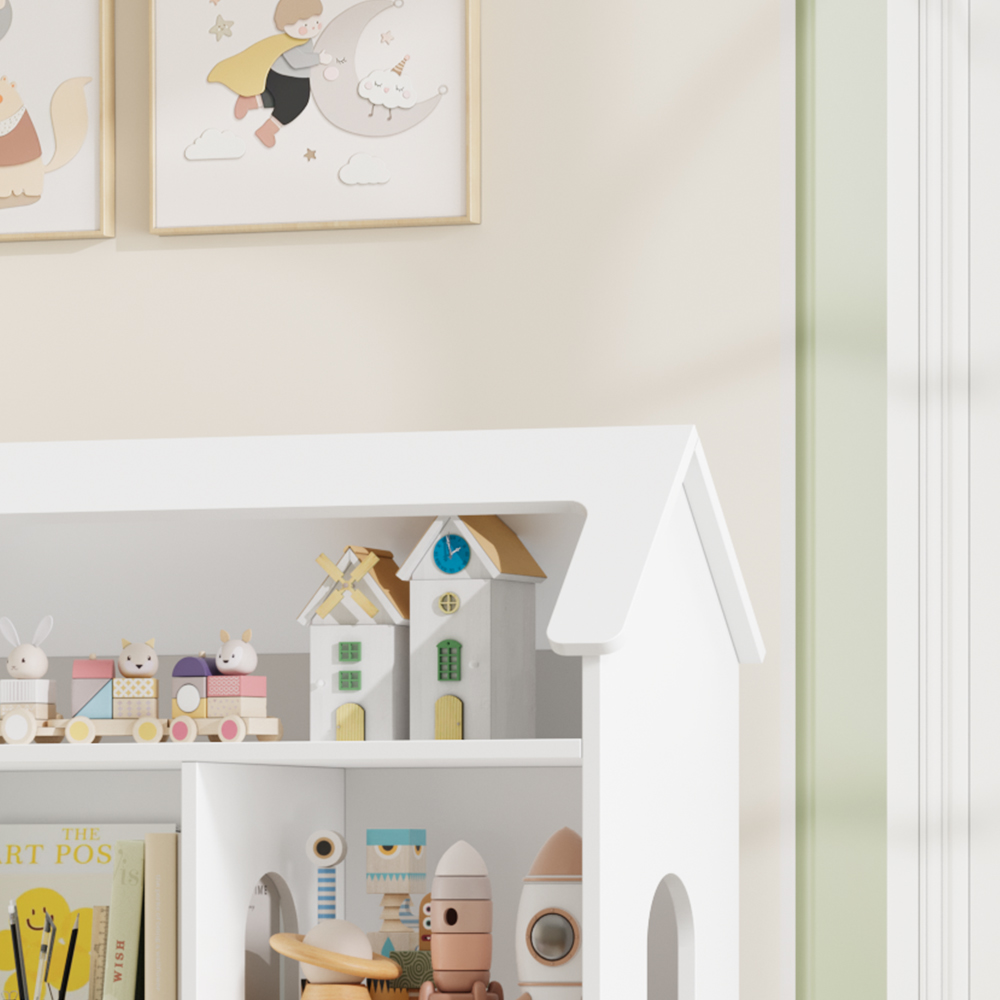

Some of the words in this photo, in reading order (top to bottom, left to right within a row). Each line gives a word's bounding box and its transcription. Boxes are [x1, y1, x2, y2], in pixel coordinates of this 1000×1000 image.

[62, 827, 101, 841] THE
[55, 844, 114, 865] POS
[113, 940, 125, 983] WISH
